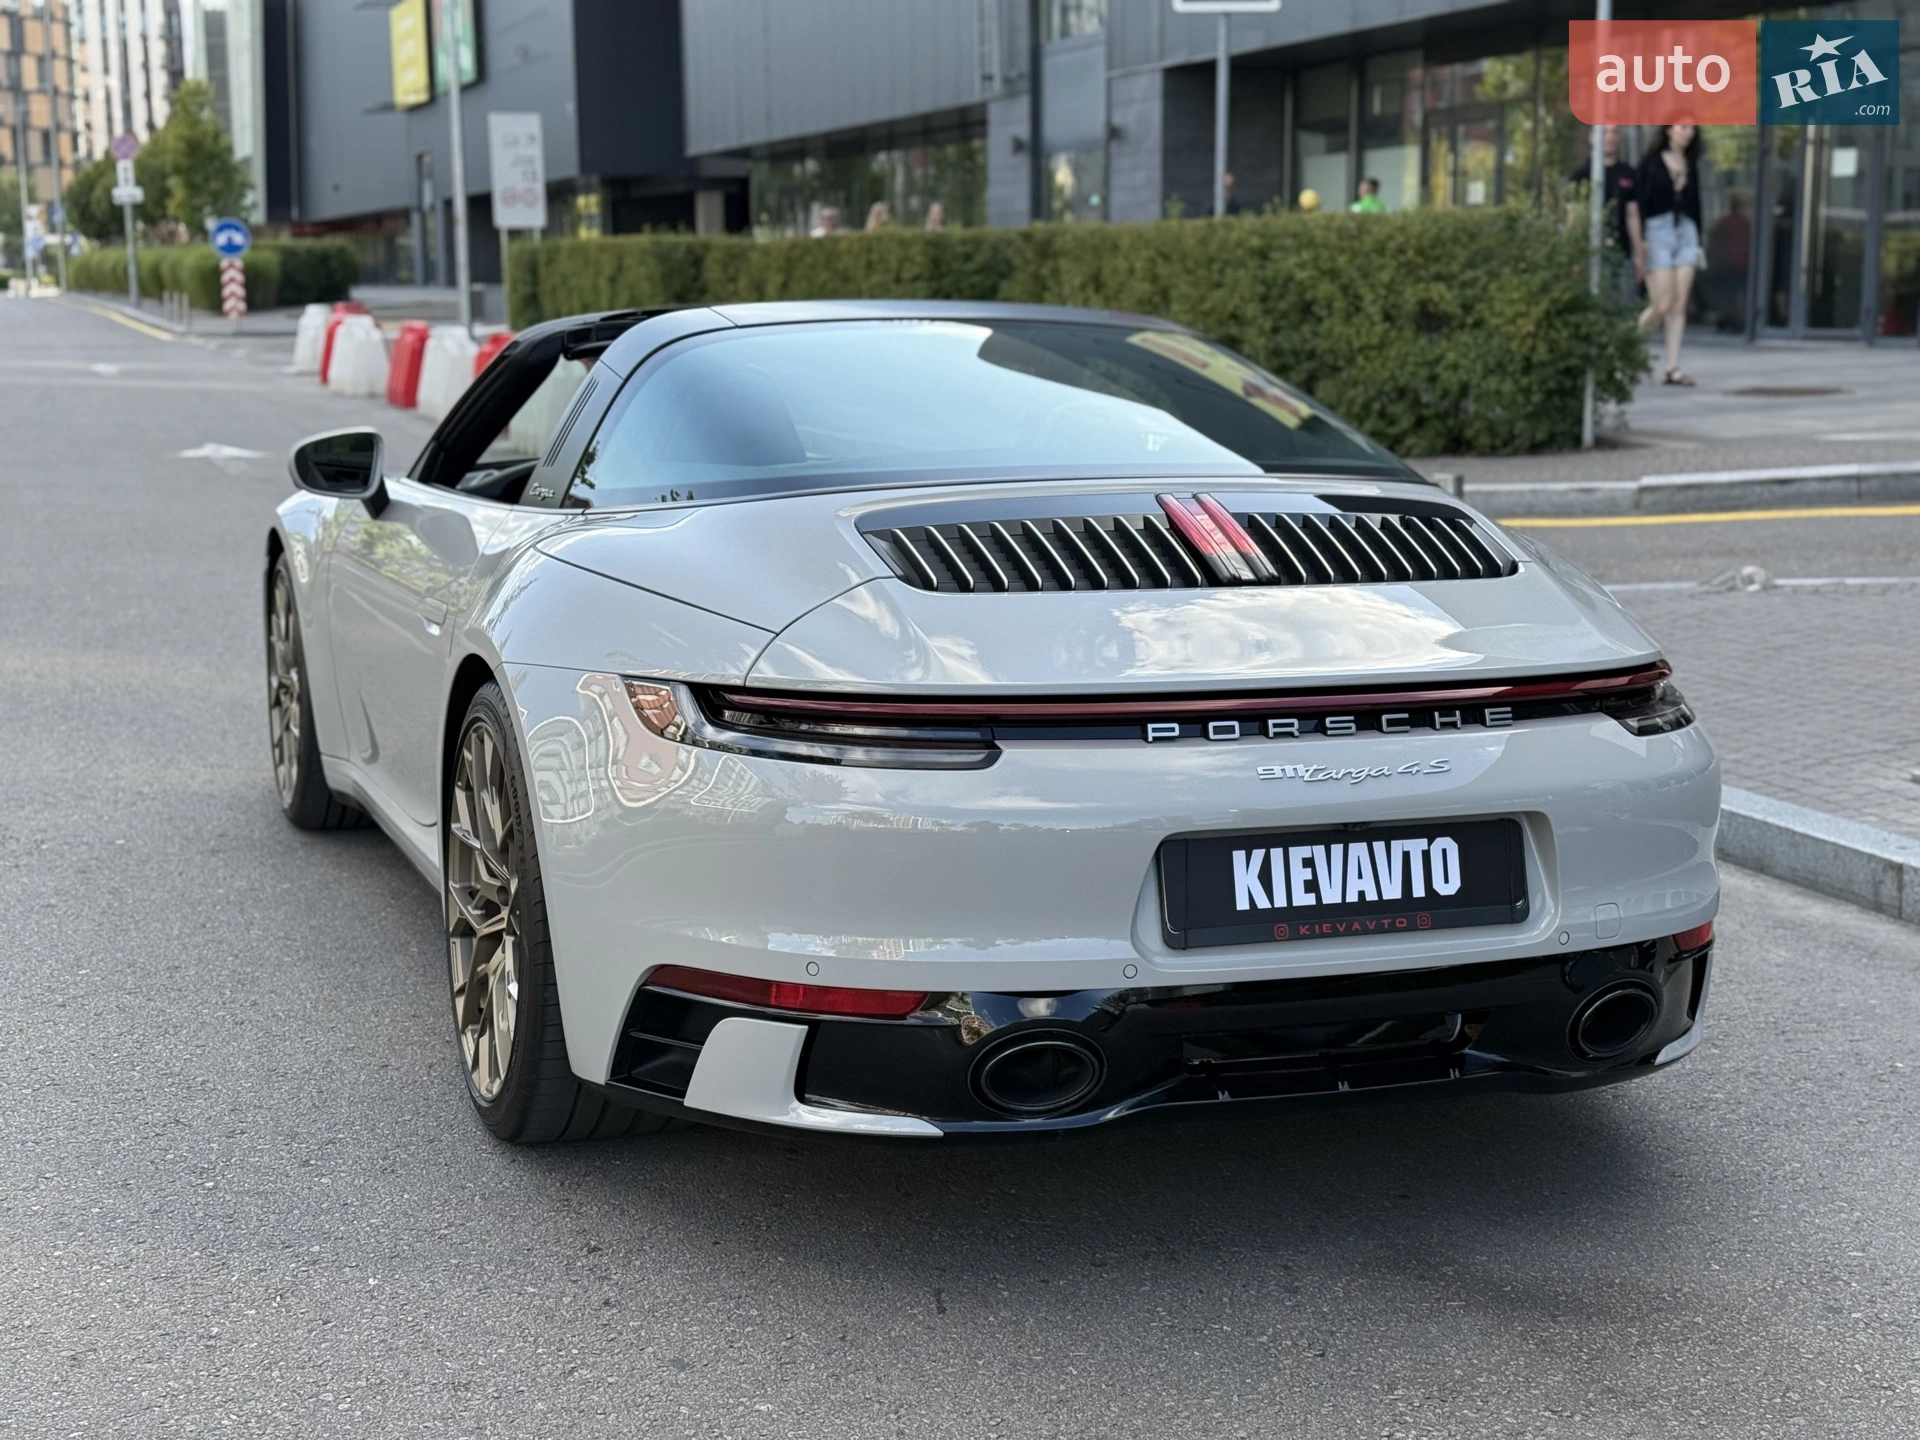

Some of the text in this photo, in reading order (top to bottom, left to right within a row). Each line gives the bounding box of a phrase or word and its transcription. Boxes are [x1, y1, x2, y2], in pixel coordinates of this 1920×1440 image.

[1147, 706, 1513, 742] PORSCHE
[510, 774, 528, 896] GOODYE
[1232, 836, 1462, 911] KIEVAVTO
[1299, 918, 1407, 935] KIEVAVTO
